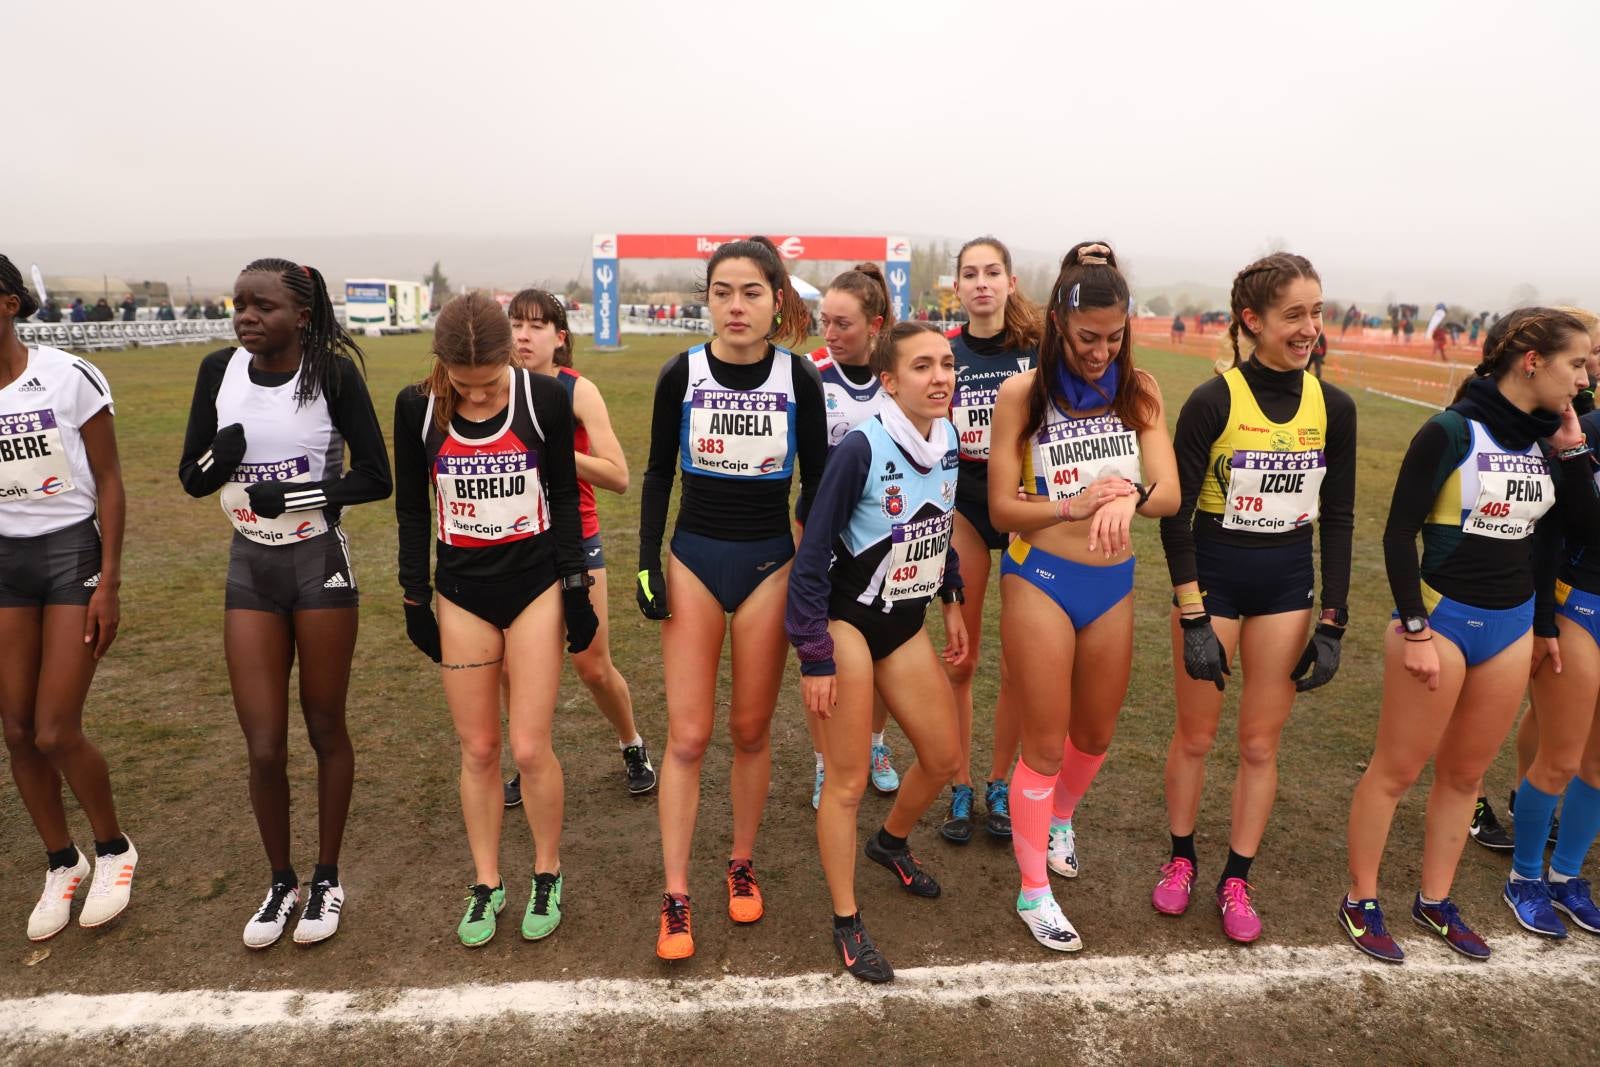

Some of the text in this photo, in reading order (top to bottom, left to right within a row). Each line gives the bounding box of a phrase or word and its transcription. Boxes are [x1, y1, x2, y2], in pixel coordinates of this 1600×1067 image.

[704, 391, 777, 403] DIPUTACIÓN
[961, 389, 998, 399] DIPUTA
[961, 397, 996, 407] BUR
[703, 400, 777, 411] BURGOS
[709, 413, 772, 436] ANGELA
[1048, 415, 1122, 434] DIPUTACIÓN
[961, 430, 983, 444] 407
[1049, 424, 1124, 442] BURGOS
[0, 435, 51, 463] BERE
[697, 438, 725, 454] 383
[1049, 434, 1135, 467] MARCHANTE
[447, 453, 527, 466] DIPUTACIÓN
[1245, 451, 1318, 462] DIPUTACIÓN
[235, 461, 297, 474] PUTACIÓN
[448, 462, 527, 475] BURGOS
[698, 457, 749, 473] iberCaja
[1245, 460, 1318, 470] BURGOS
[1490, 463, 1545, 474] BURGOS
[1053, 467, 1079, 485] 401
[1260, 473, 1305, 493] IZCUE
[454, 475, 526, 500] BEREIJO
[1506, 475, 1543, 502] PEÑA
[450, 501, 476, 518] 372
[1234, 496, 1263, 512] 378
[1480, 502, 1511, 517] 405
[233, 508, 257, 525] 304
[1231, 514, 1285, 530] iberCaja
[240, 526, 284, 542] iberCaja
[453, 518, 502, 536] iberCaja
[1473, 518, 1523, 535] iberCaja
[892, 565, 918, 582] 430
[890, 581, 936, 597] iberCaja
